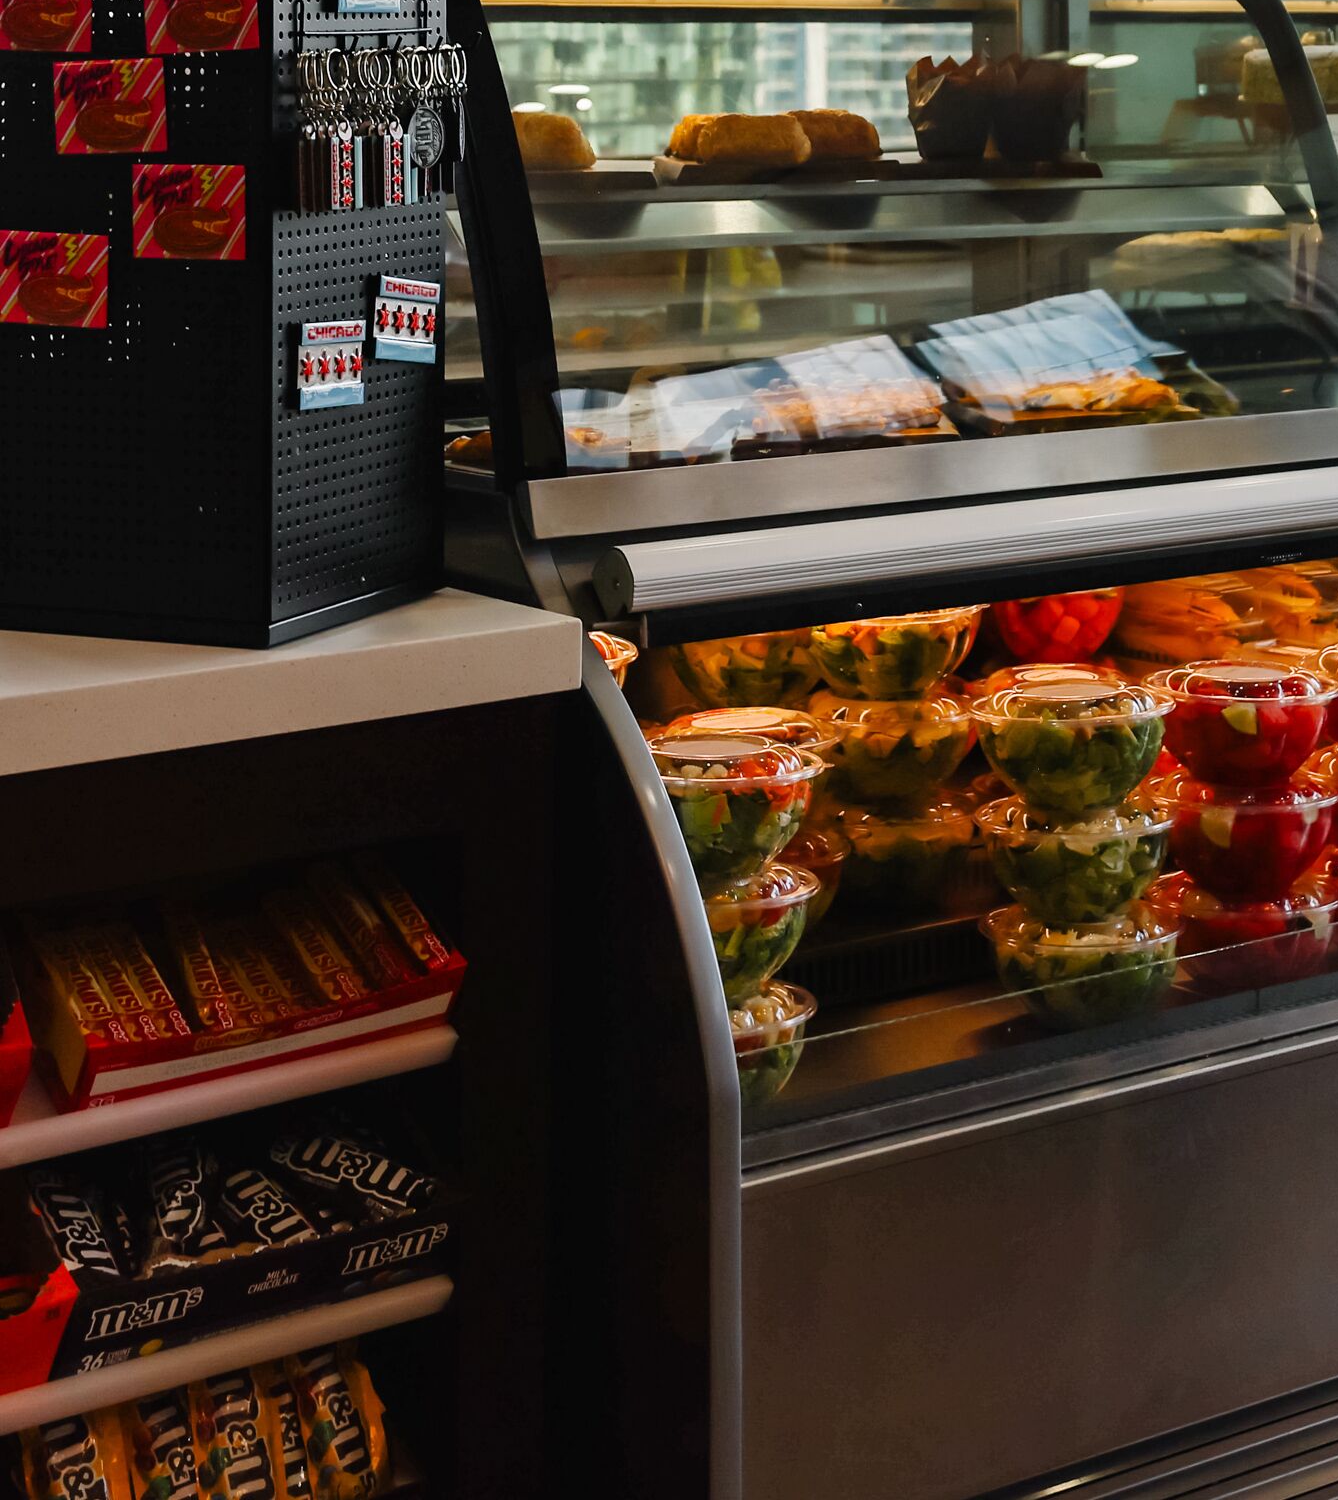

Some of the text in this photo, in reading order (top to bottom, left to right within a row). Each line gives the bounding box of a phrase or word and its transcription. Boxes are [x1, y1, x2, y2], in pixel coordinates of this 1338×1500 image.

[385, 280, 437, 298] CHICAGO
[307, 323, 363, 340] CHICAGO
[340, 1222, 450, 1276] m&m's
[84, 1286, 205, 1343] m&m's
[77, 1351, 105, 1375] 36
